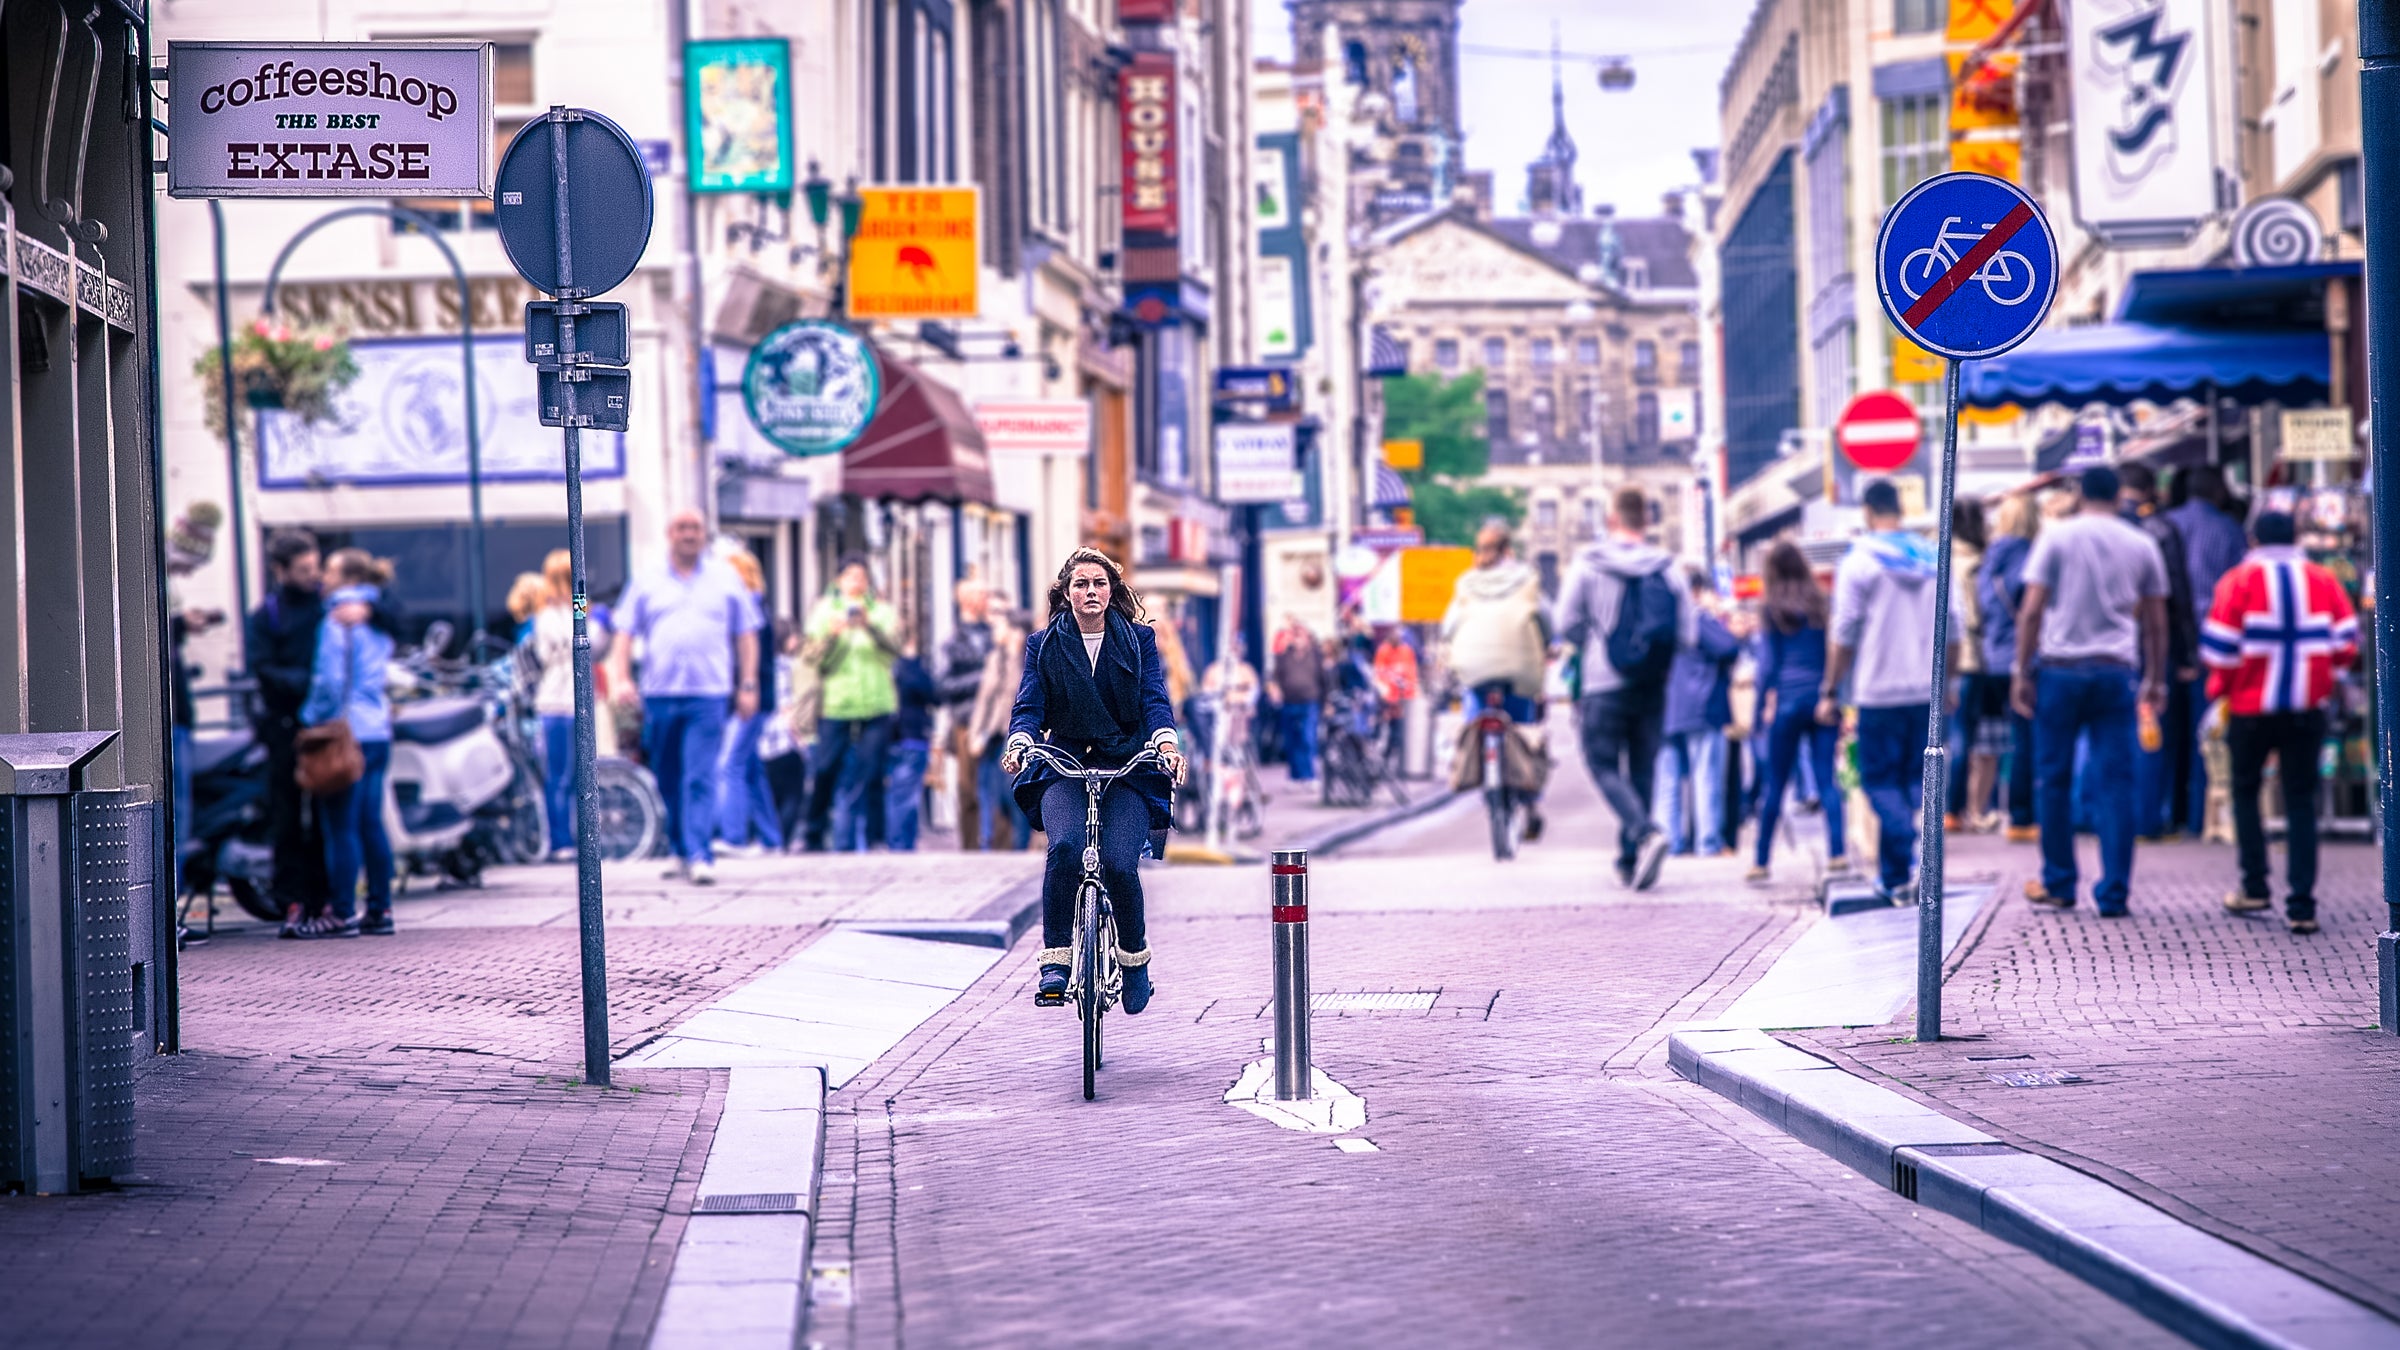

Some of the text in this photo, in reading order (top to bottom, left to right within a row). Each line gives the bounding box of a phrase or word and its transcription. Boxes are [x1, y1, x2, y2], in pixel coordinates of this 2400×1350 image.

[200, 61, 458, 121] coffeeshop
[275, 114, 381, 129] THE BEST
[1129, 76, 1168, 211] HOUSE
[227, 143, 430, 179] EXTASE
